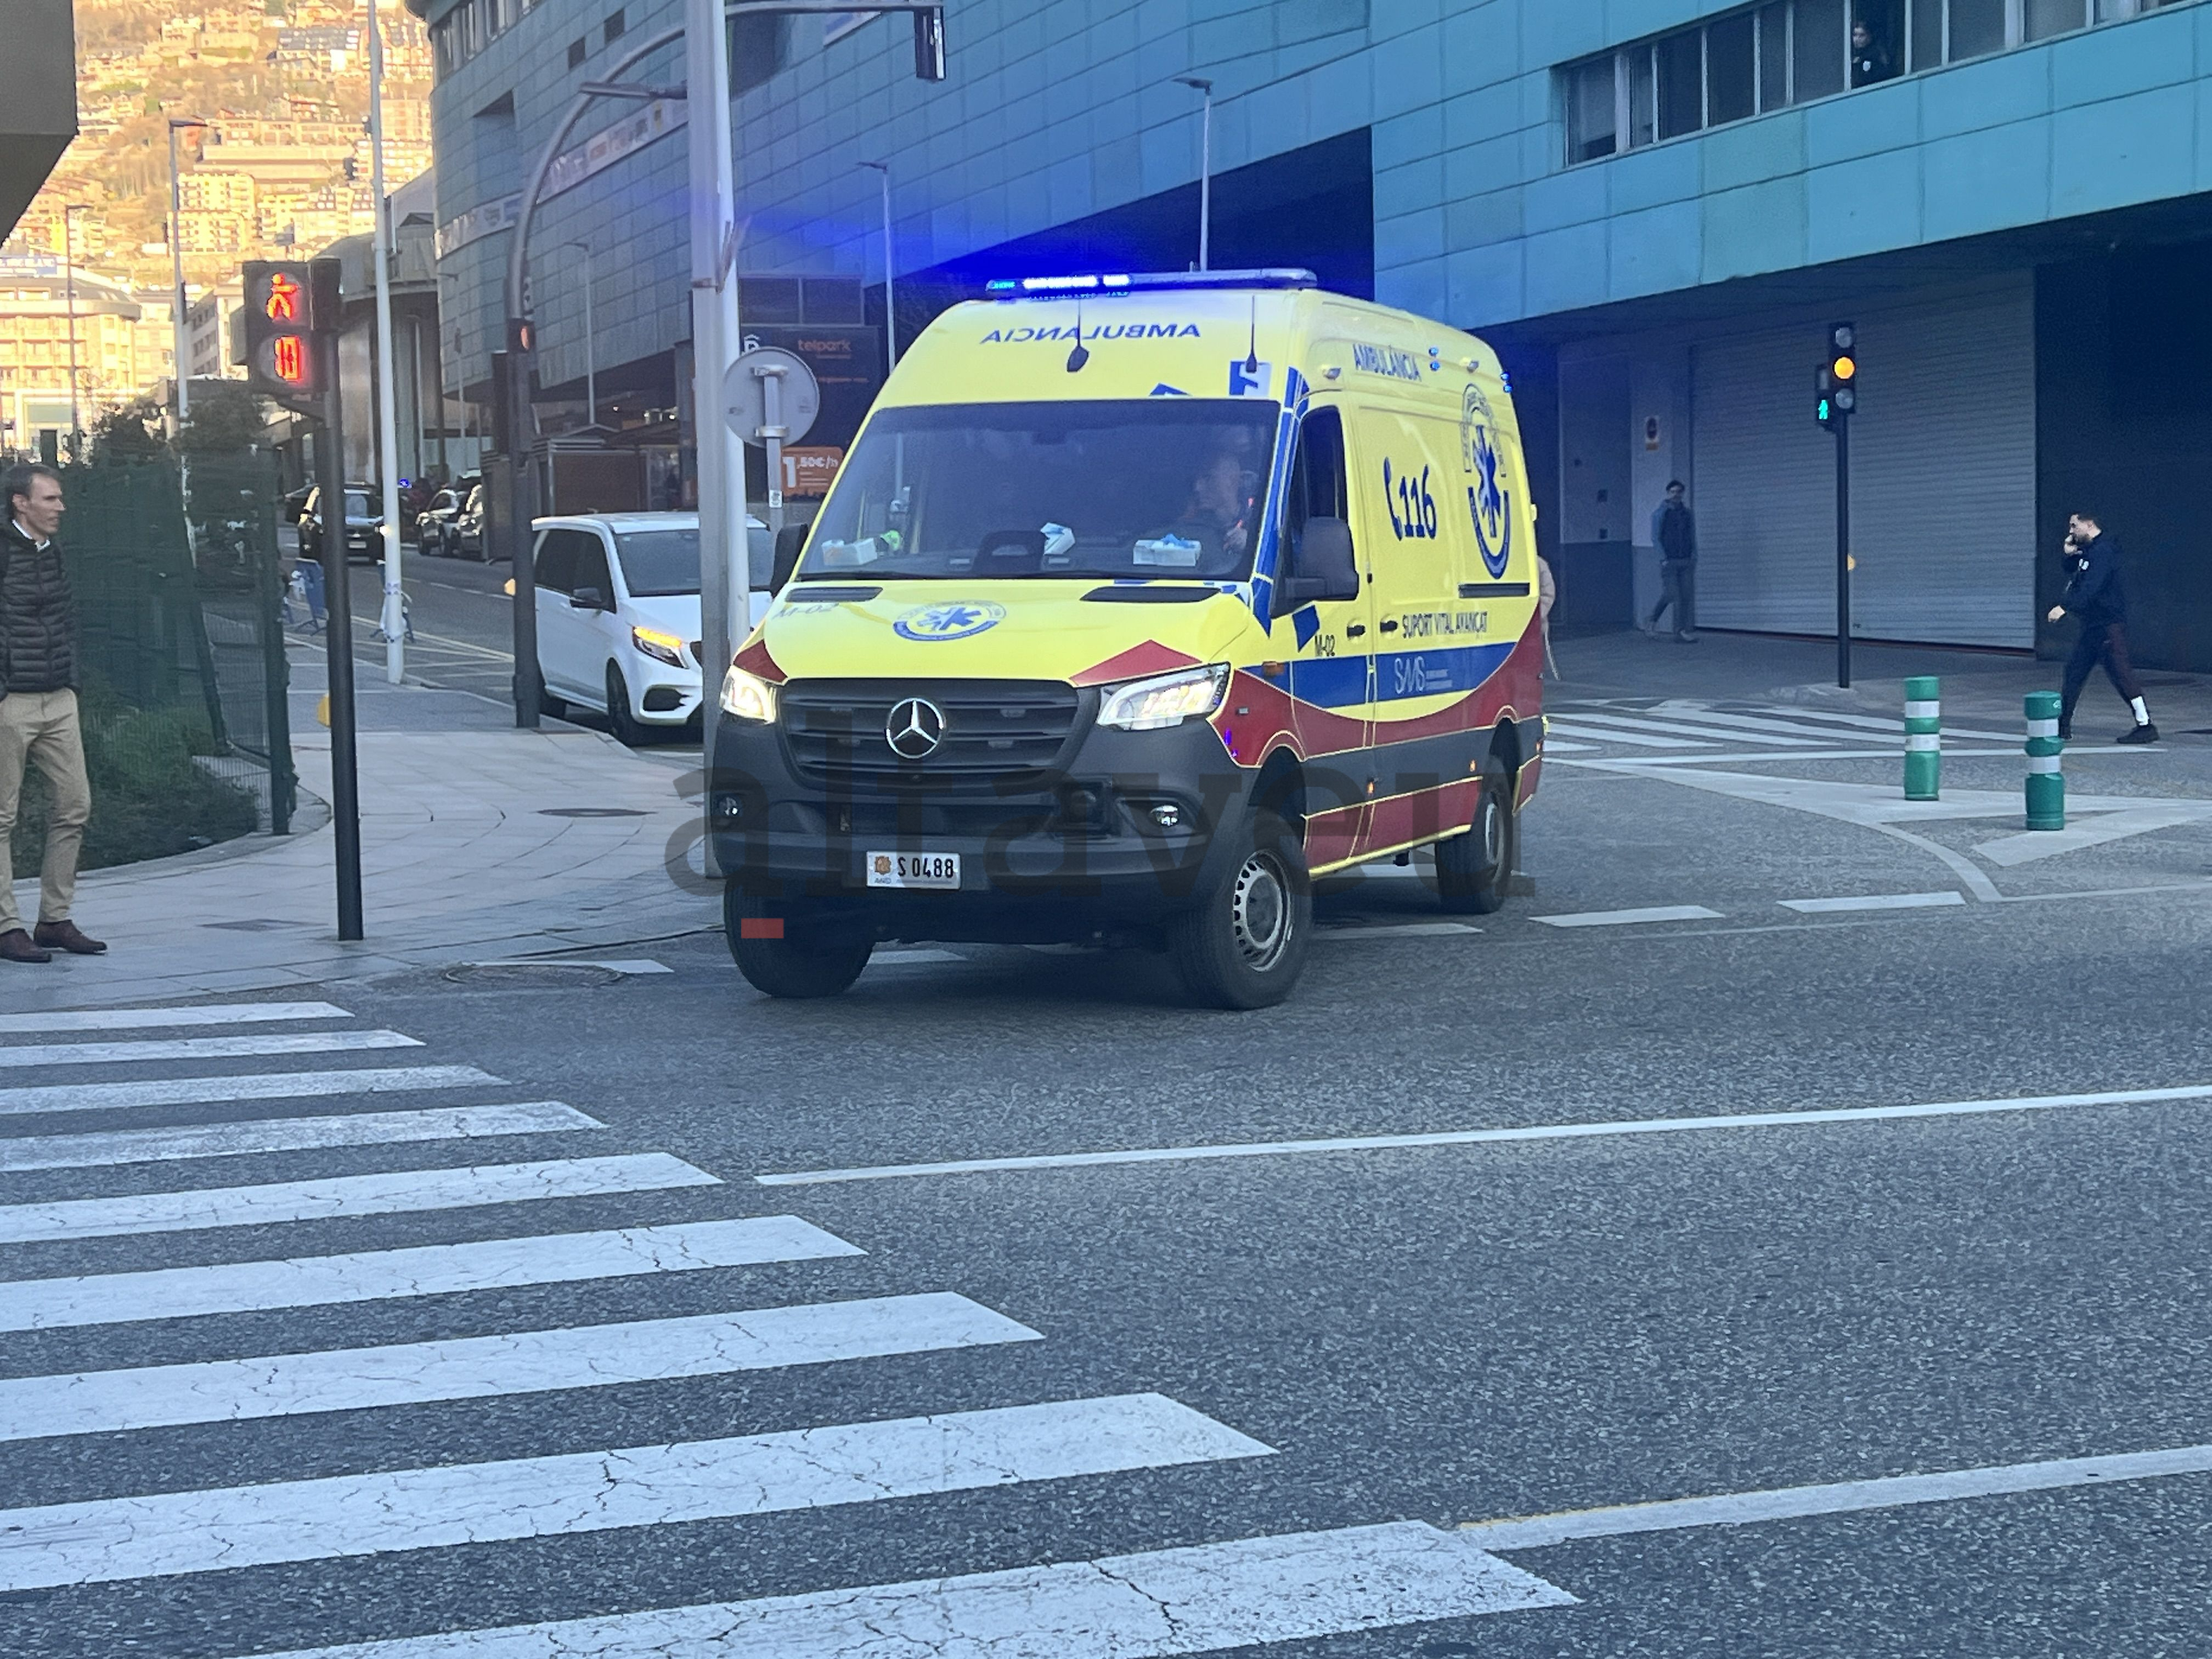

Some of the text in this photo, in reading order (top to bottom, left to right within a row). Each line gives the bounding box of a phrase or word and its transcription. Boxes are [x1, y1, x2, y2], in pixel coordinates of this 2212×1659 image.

[1400, 464, 1436, 540] 116
[1314, 634, 1336, 657] M-02
[898, 856, 954, 878] S 0488
